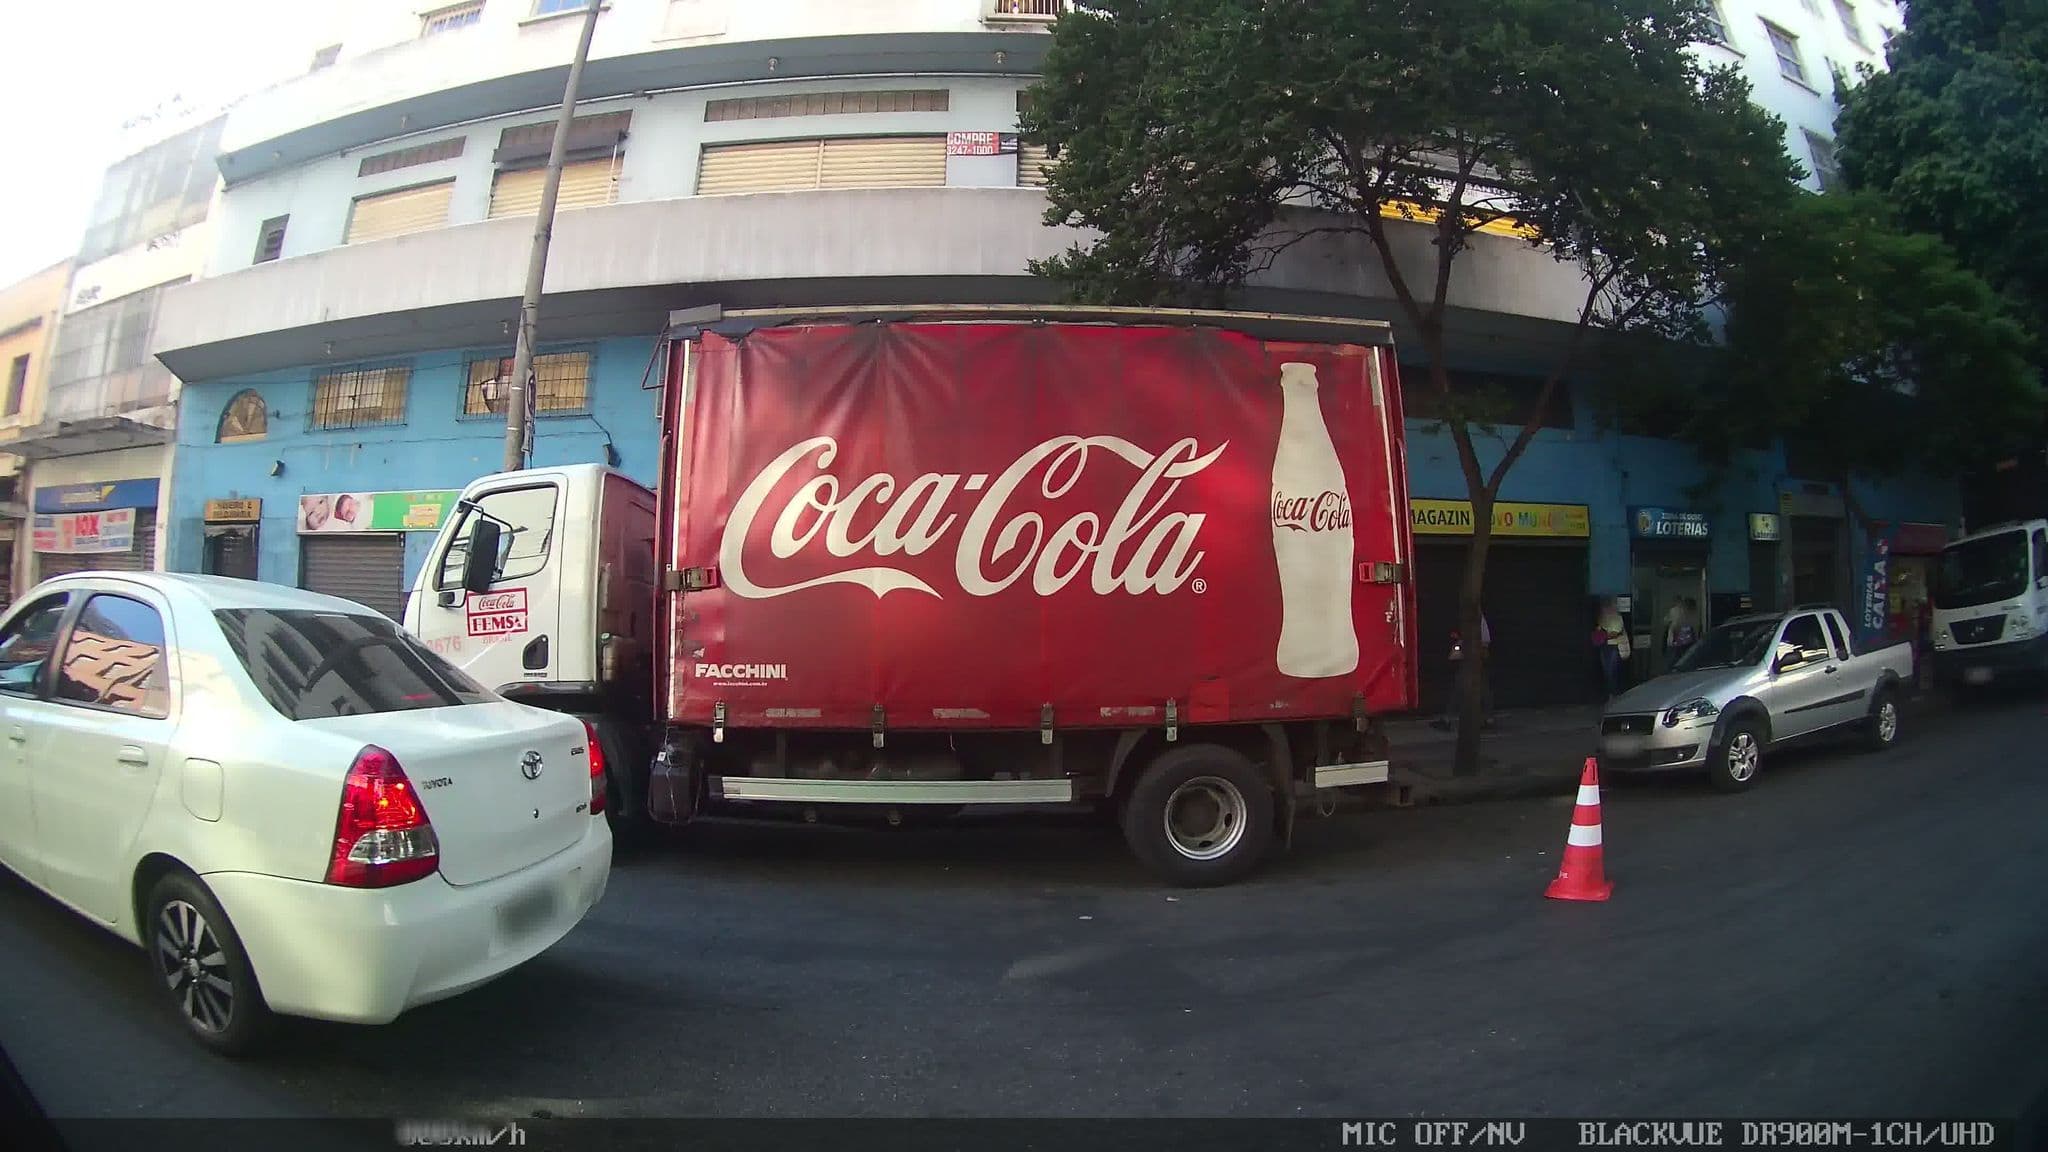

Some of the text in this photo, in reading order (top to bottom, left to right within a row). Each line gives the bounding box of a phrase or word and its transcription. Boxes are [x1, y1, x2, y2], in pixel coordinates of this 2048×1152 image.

[719, 435, 1231, 600] Coca-Cola
[1273, 490, 1350, 533] Coca-Cola
[1411, 509, 1470, 526] AGAZIN
[1656, 521, 1709, 536] LOTERIAS
[1864, 575, 1873, 628] LOTERIAS
[1872, 560, 1887, 630] CAIXA
[694, 663, 787, 679] FACCHINI
[422, 777, 453, 790] TOYOTA
